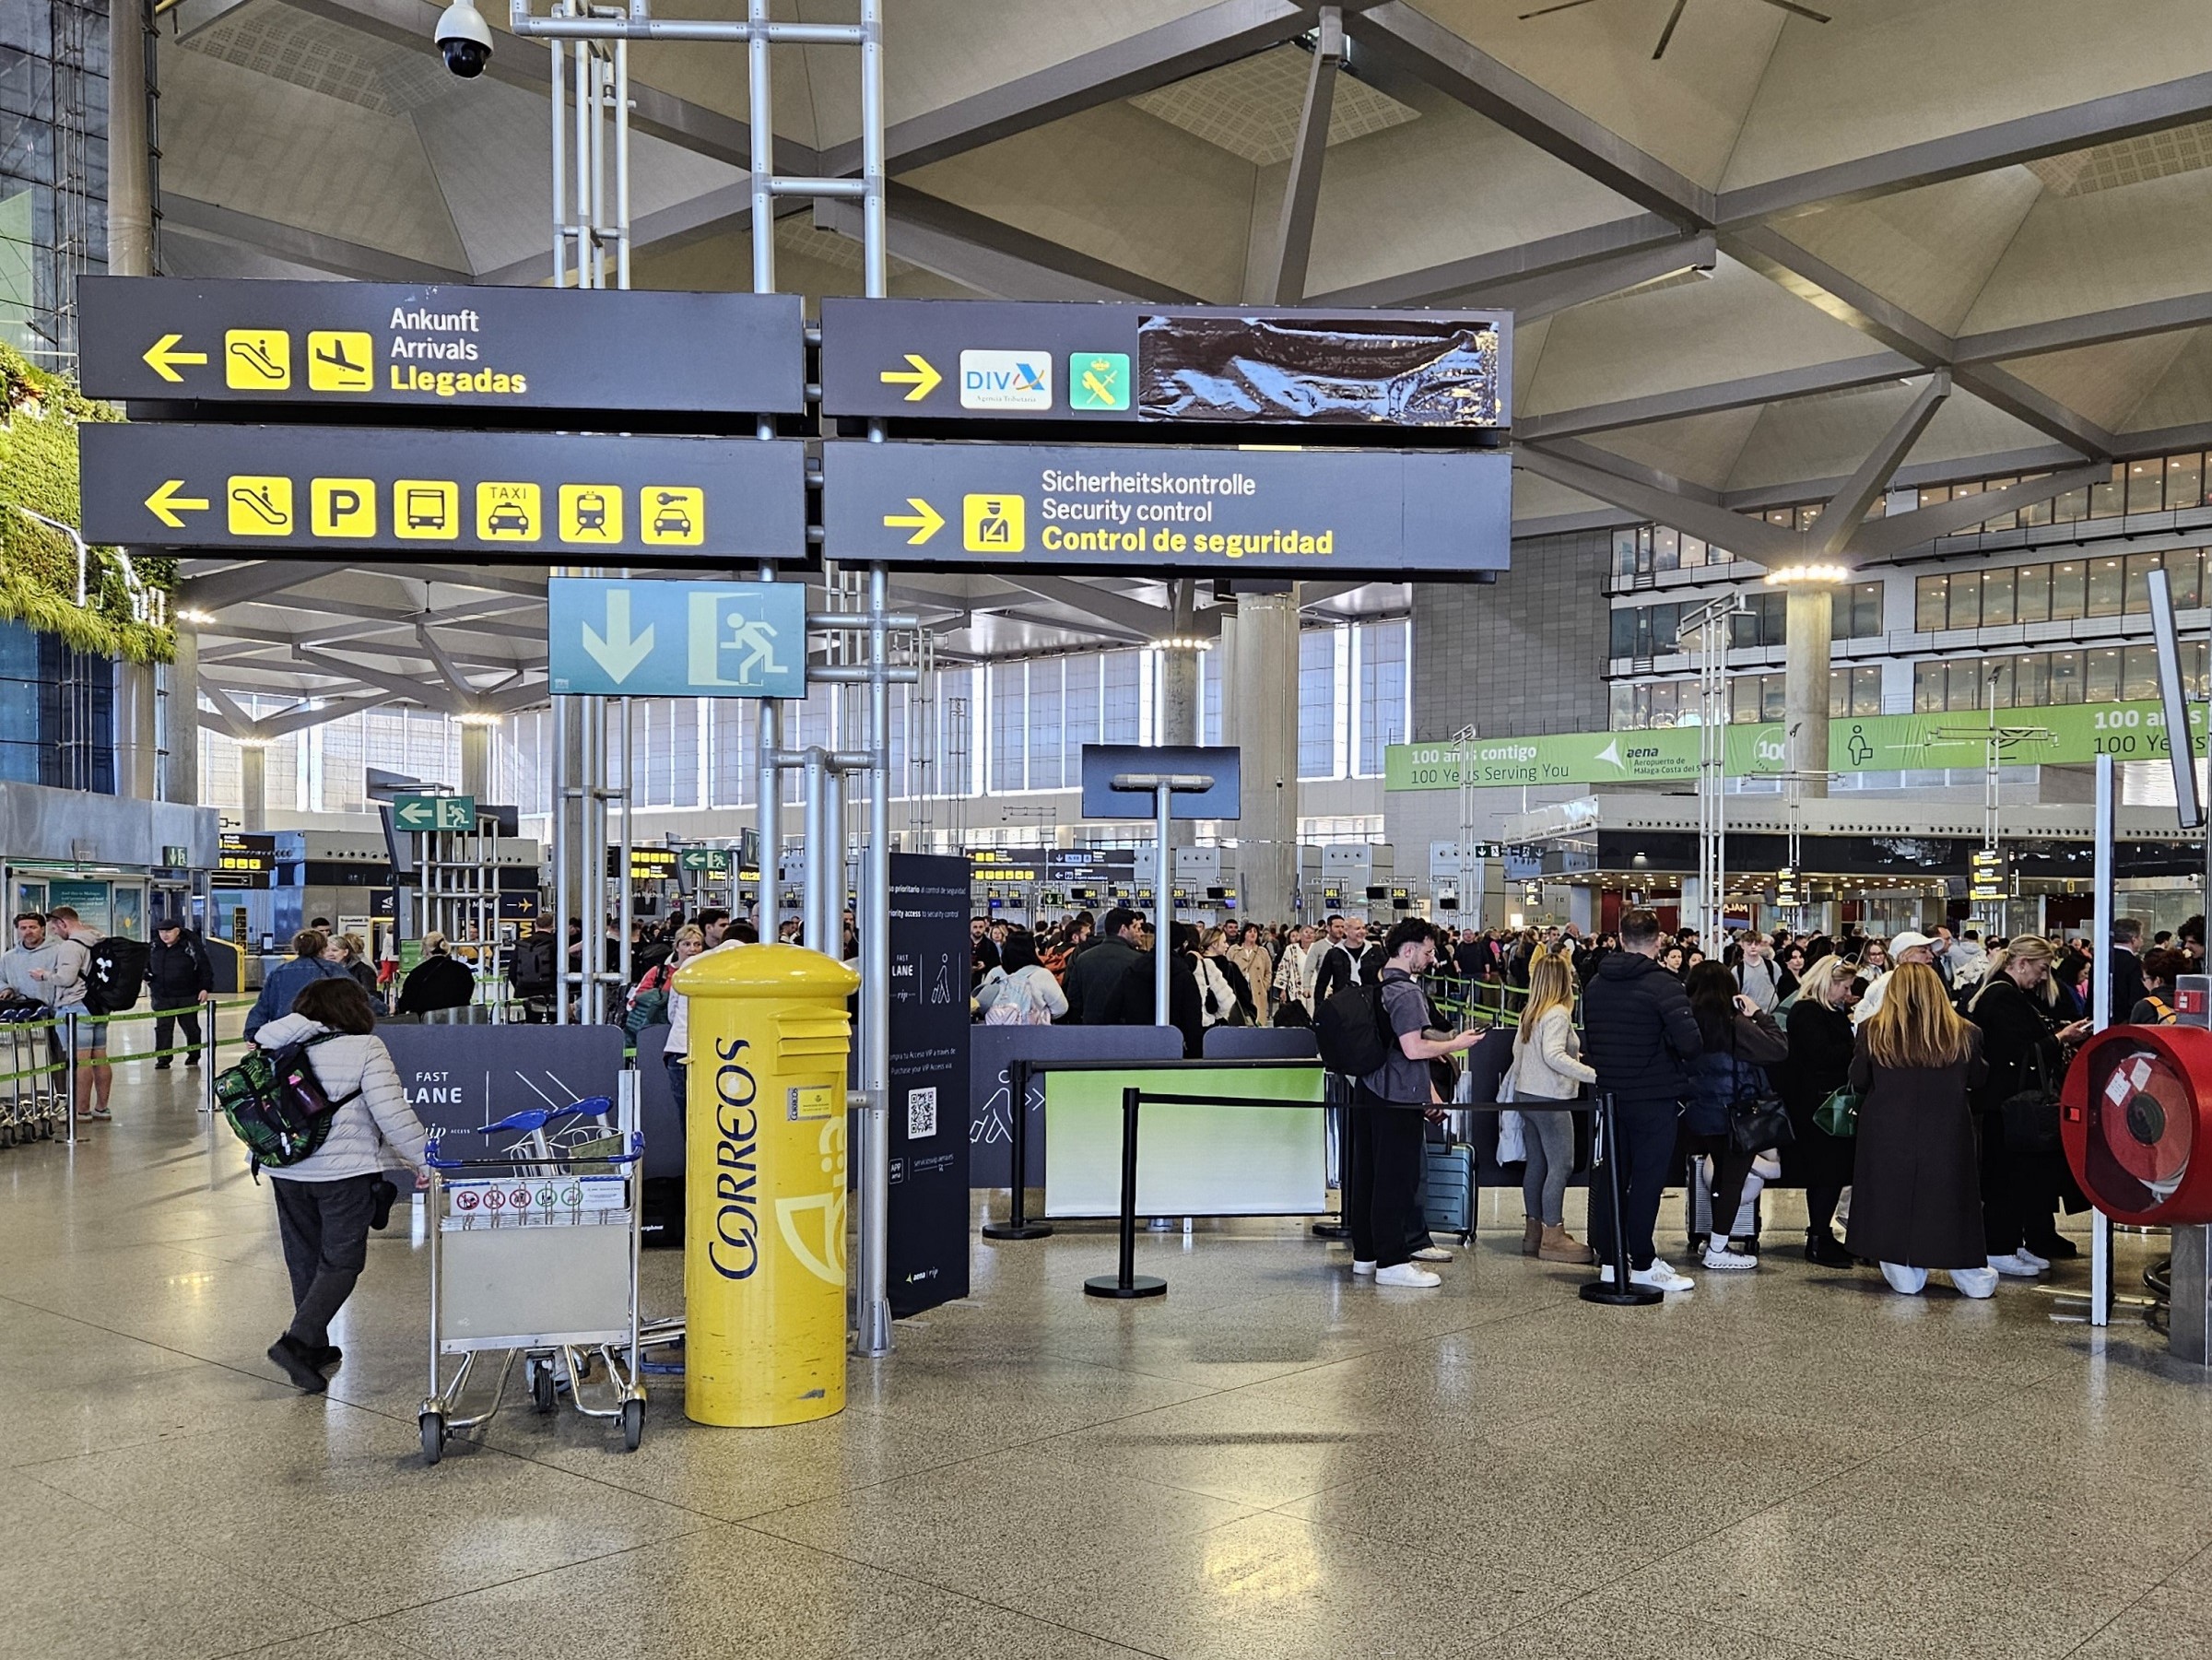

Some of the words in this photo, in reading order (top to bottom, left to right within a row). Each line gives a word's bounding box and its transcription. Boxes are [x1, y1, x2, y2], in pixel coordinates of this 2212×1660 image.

[390, 307, 479, 332] Ankunft
[391, 336, 478, 360] Arrivals
[390, 365, 527, 396] Llegadas
[1041, 469, 1256, 495] Sicherheitskontrolle
[489, 487, 527, 500] TAXI
[330, 489, 360, 527] P
[1041, 498, 1132, 524] Security
[1136, 501, 1212, 522] control
[1041, 525, 1146, 551] Control
[1152, 528, 1186, 552] de
[1194, 530, 1333, 559] seguridad
[2094, 710, 2139, 729] 100
[2146, 708, 2202, 726] as
[1626, 748, 1659, 758] aena
[2093, 736, 2136, 754] 100
[2146, 734, 2206, 752] Yes
[1411, 749, 1439, 764] 100
[1480, 745, 1537, 762] contigo
[1633, 759, 1675, 767] Aeropuerto
[1411, 769, 1438, 783] 100
[1442, 767, 1480, 783] Yers
[1485, 764, 1537, 783] Serving
[1542, 763, 1570, 778] You
[894, 885, 920, 894] prioritario
[888, 909, 903, 919] riority
[904, 910, 921, 918] access
[927, 911, 944, 919] security
[945, 910, 959, 918] control
[891, 964, 913, 977] LANE
[416, 1071, 449, 1082] FAST
[403, 1087, 462, 1104] LANE
[789, 1088, 798, 1121] CORREOS
[709, 1038, 759, 1280] CORREOS
[890, 1162, 901, 1172] APP
[912, 1272, 925, 1281] aena
